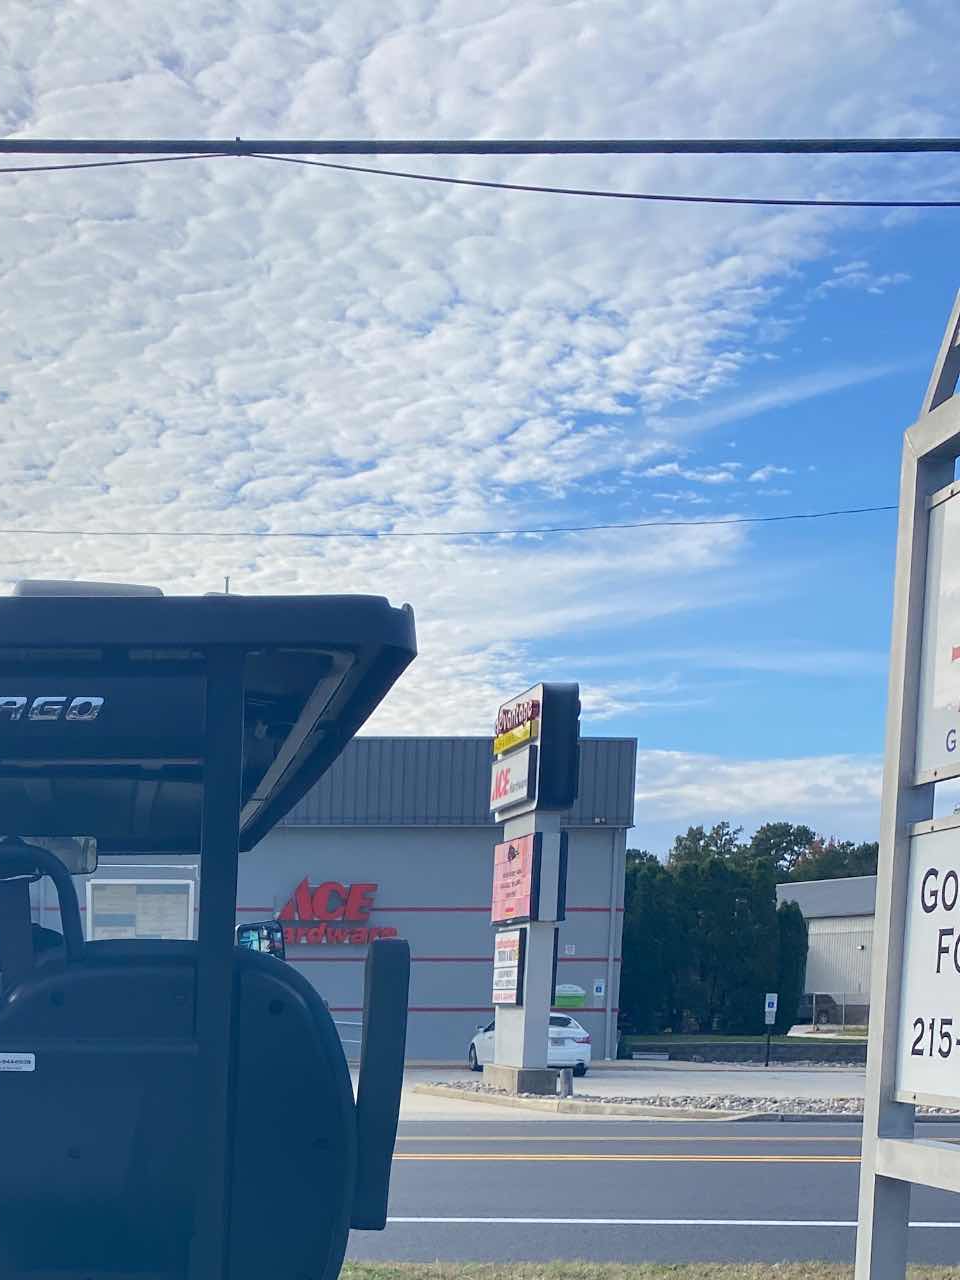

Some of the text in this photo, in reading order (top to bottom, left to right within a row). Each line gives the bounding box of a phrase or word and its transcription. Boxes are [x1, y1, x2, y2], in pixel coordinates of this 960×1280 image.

[492, 768, 510, 800] ACE
[278, 875, 378, 921] ACE
[283, 922, 399, 945] ardware
